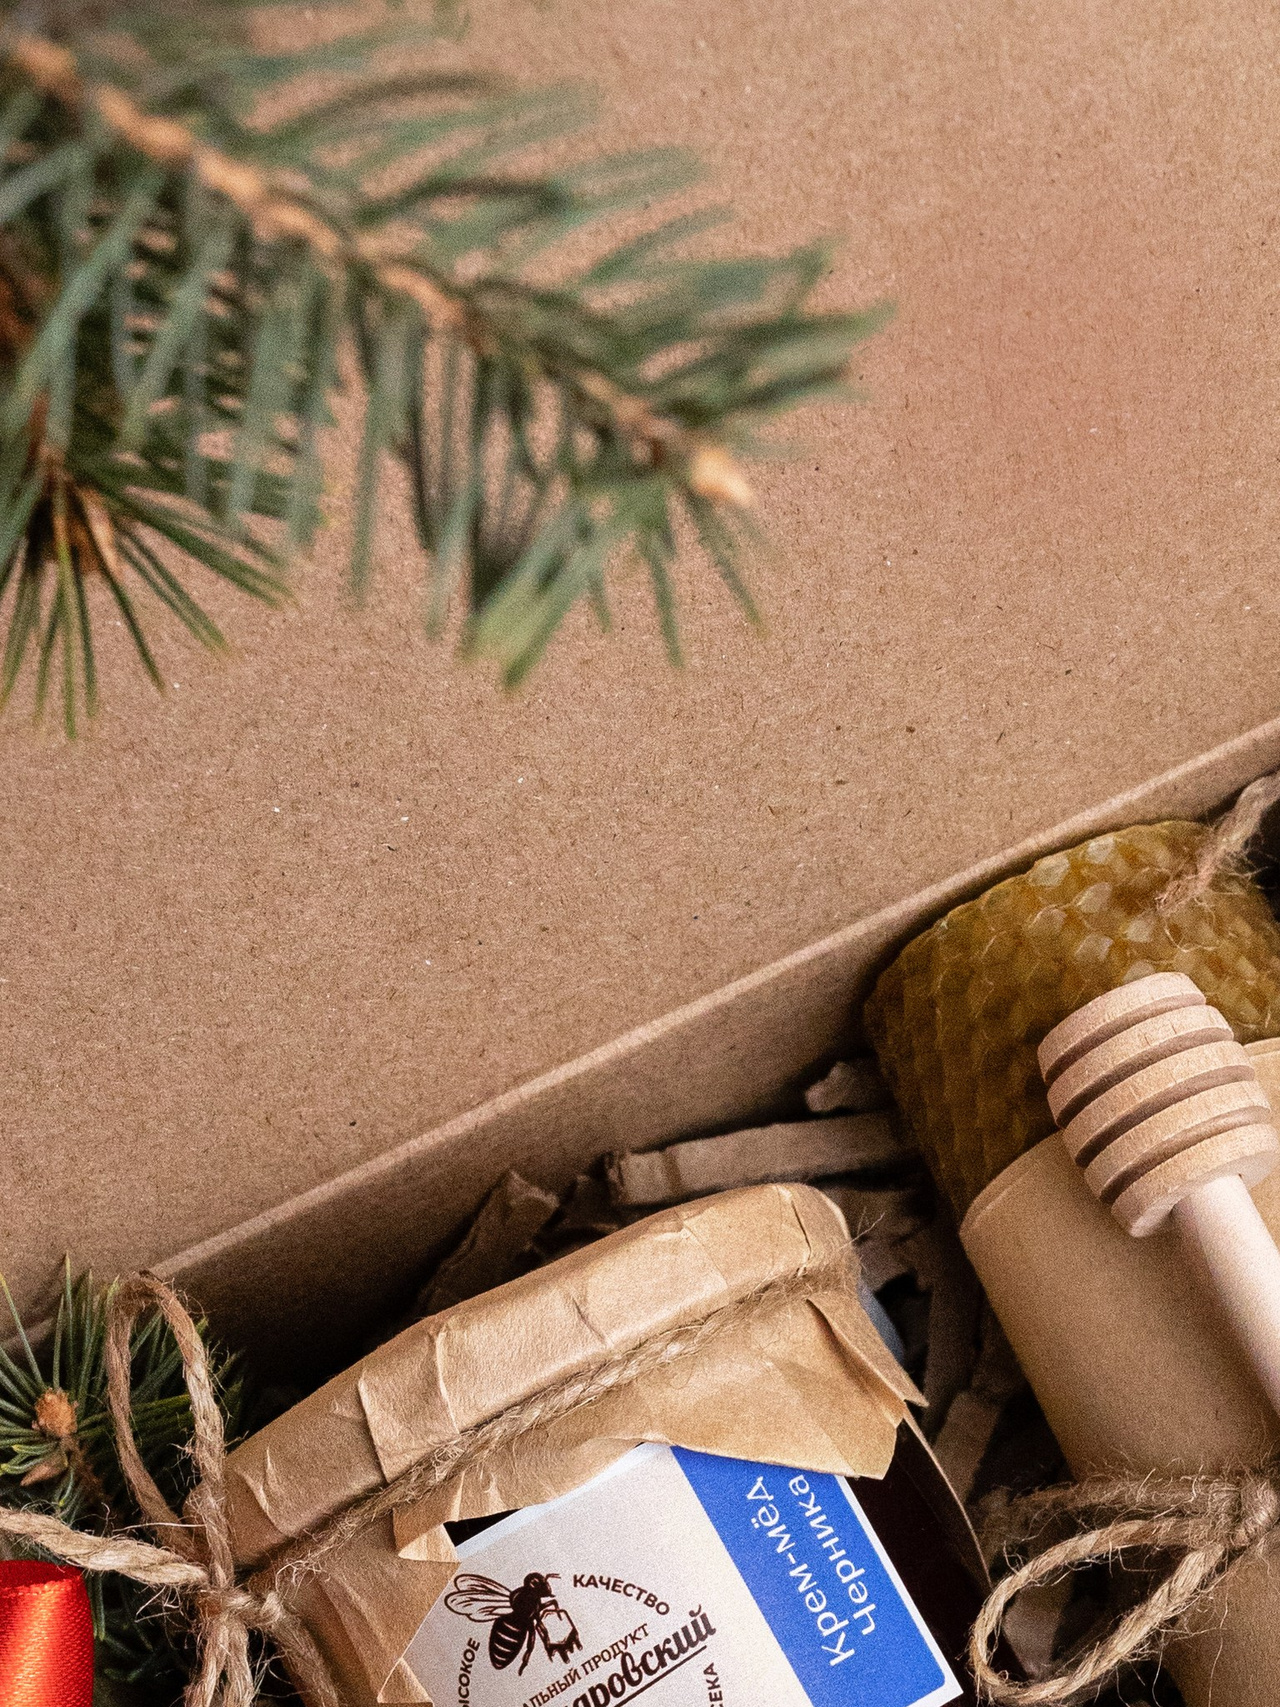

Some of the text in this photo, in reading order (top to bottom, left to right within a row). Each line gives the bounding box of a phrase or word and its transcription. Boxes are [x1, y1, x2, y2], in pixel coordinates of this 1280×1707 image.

[572, 1573, 671, 1616] КАЧЕСТВО
[747, 1477, 855, 1667] Крем-мёд
[789, 1475, 876, 1635] Черника
[581, 1624, 650, 1677] ПРОДУКТ
